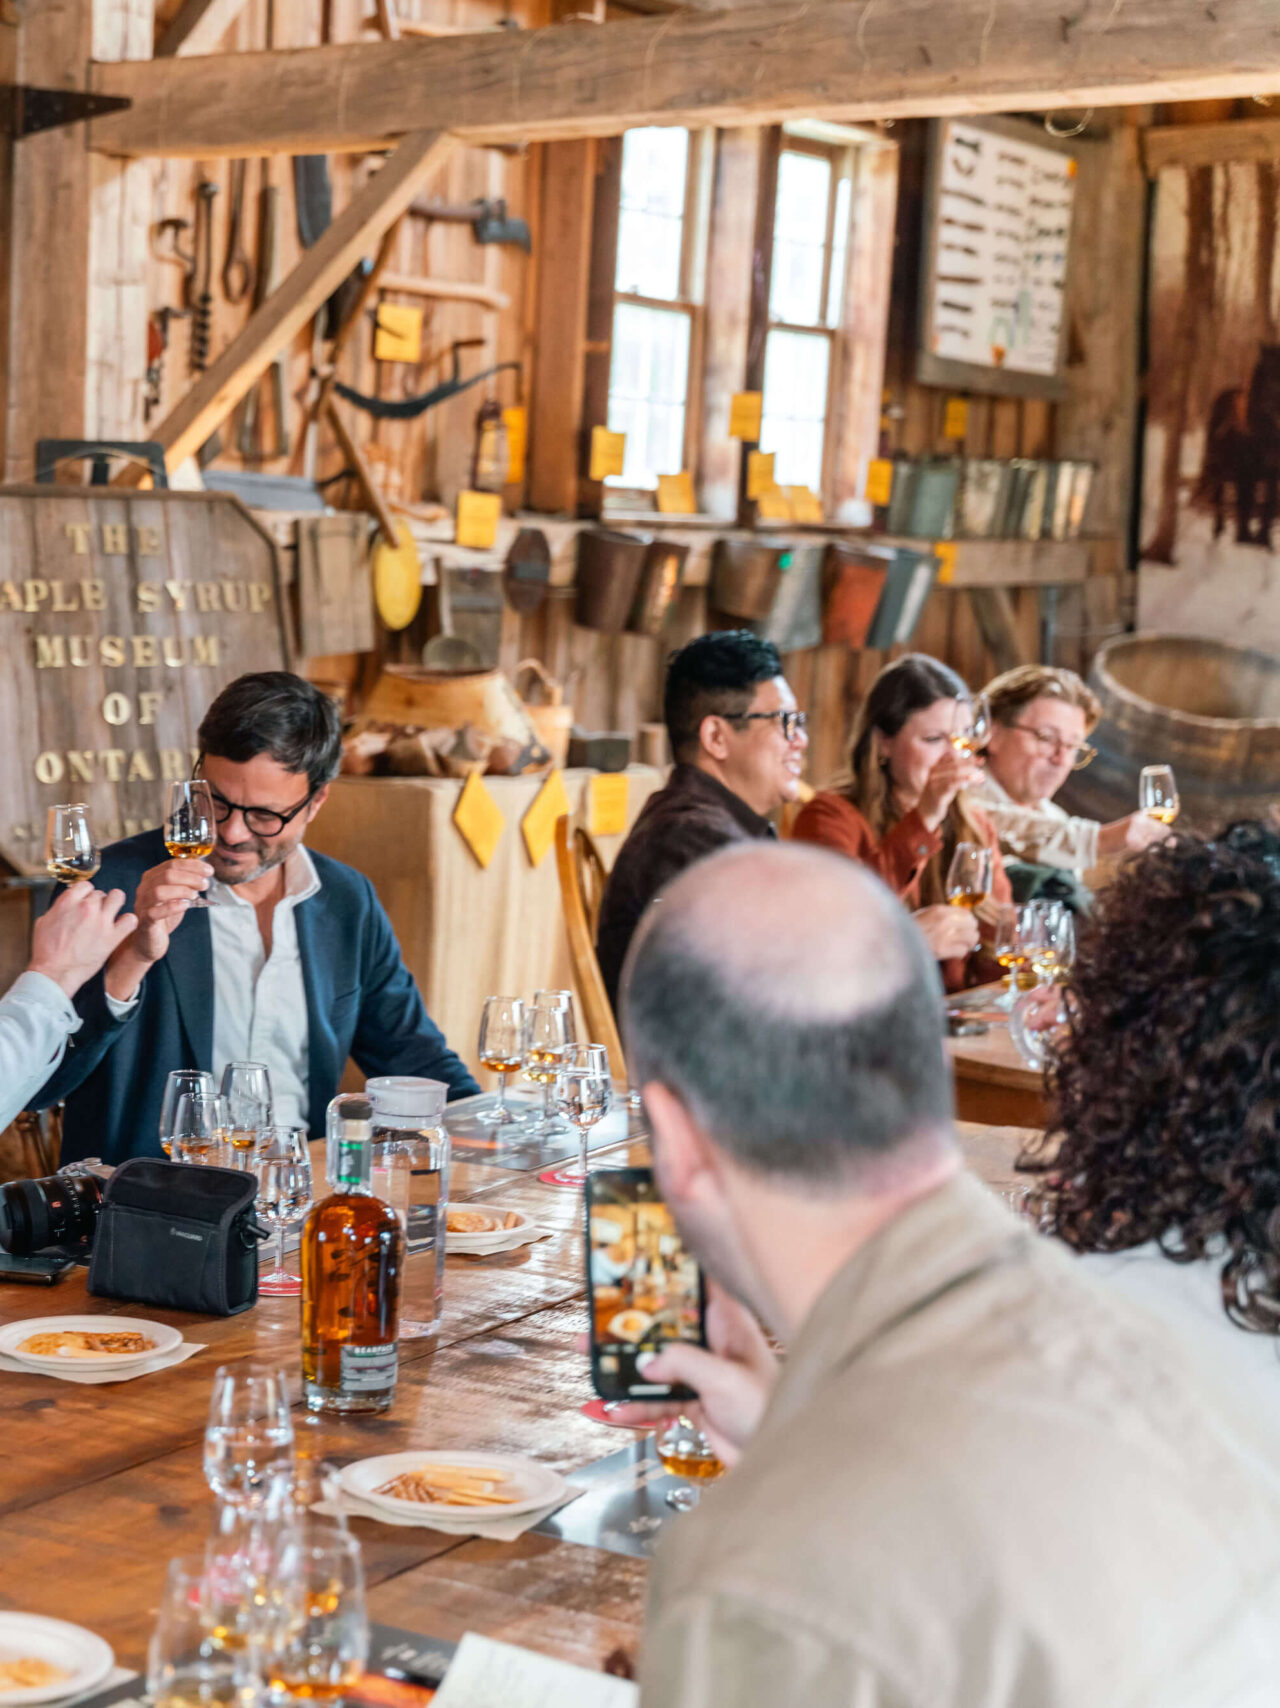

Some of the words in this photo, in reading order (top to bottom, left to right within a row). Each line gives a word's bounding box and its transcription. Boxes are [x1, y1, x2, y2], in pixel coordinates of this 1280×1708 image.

[66, 523, 163, 556] THE
[136, 579, 272, 613] SYRUP
[36, 634, 220, 668] MUSEUM
[103, 692, 164, 726] OF
